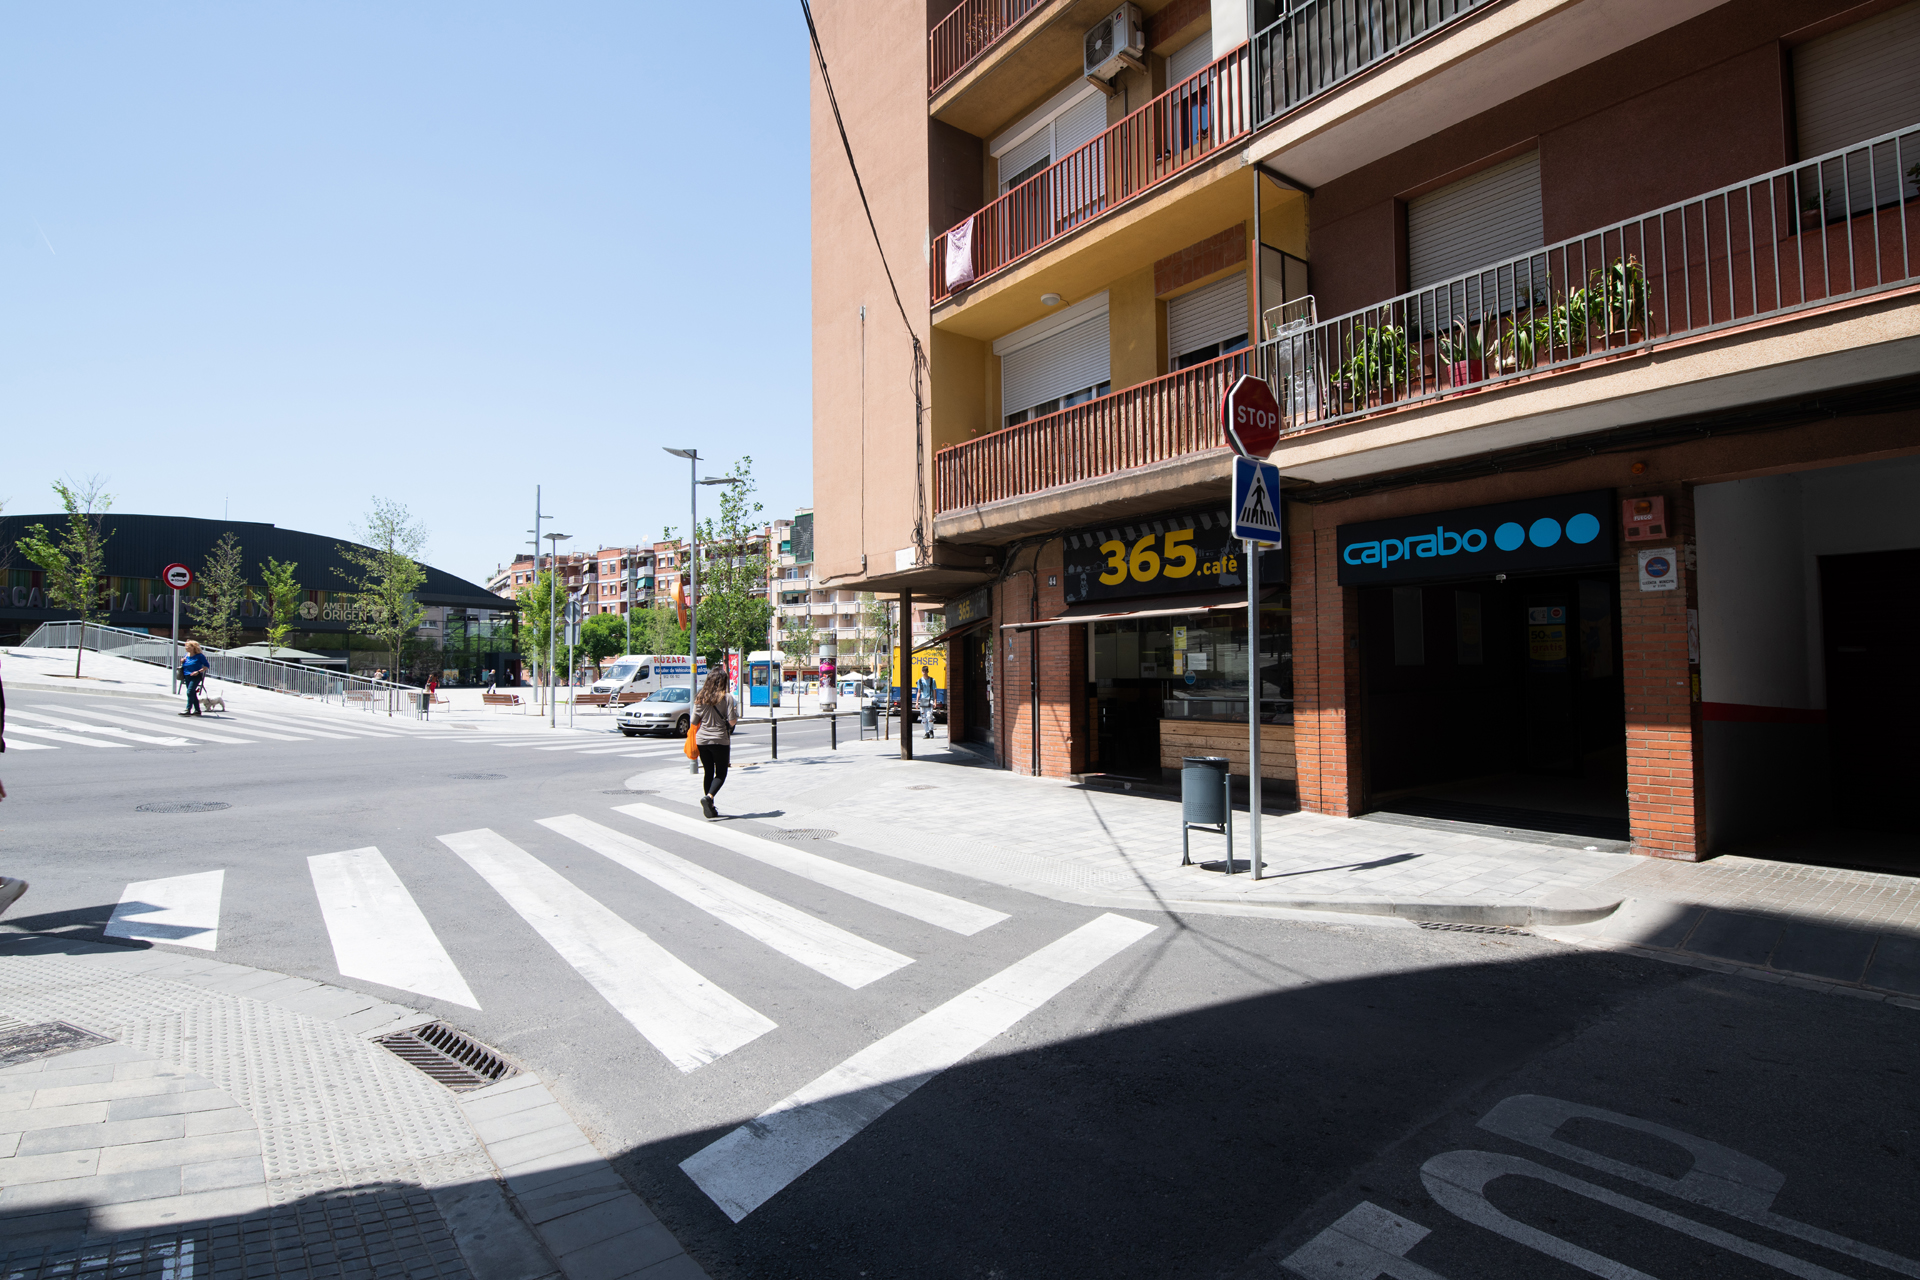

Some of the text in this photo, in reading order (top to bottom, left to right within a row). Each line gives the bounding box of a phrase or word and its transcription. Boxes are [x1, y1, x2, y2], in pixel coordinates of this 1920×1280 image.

[1237, 405, 1276, 430] STOP
[1343, 525, 1488, 569] caprabo
[1048, 576, 1056, 586] 44
[111, 592, 136, 611] LA
[322, 609, 367, 621] ORIGEN
[958, 599, 971, 621] 365
[1532, 642, 1563, 654] gratis
[653, 656, 687, 664] RUZAFA
